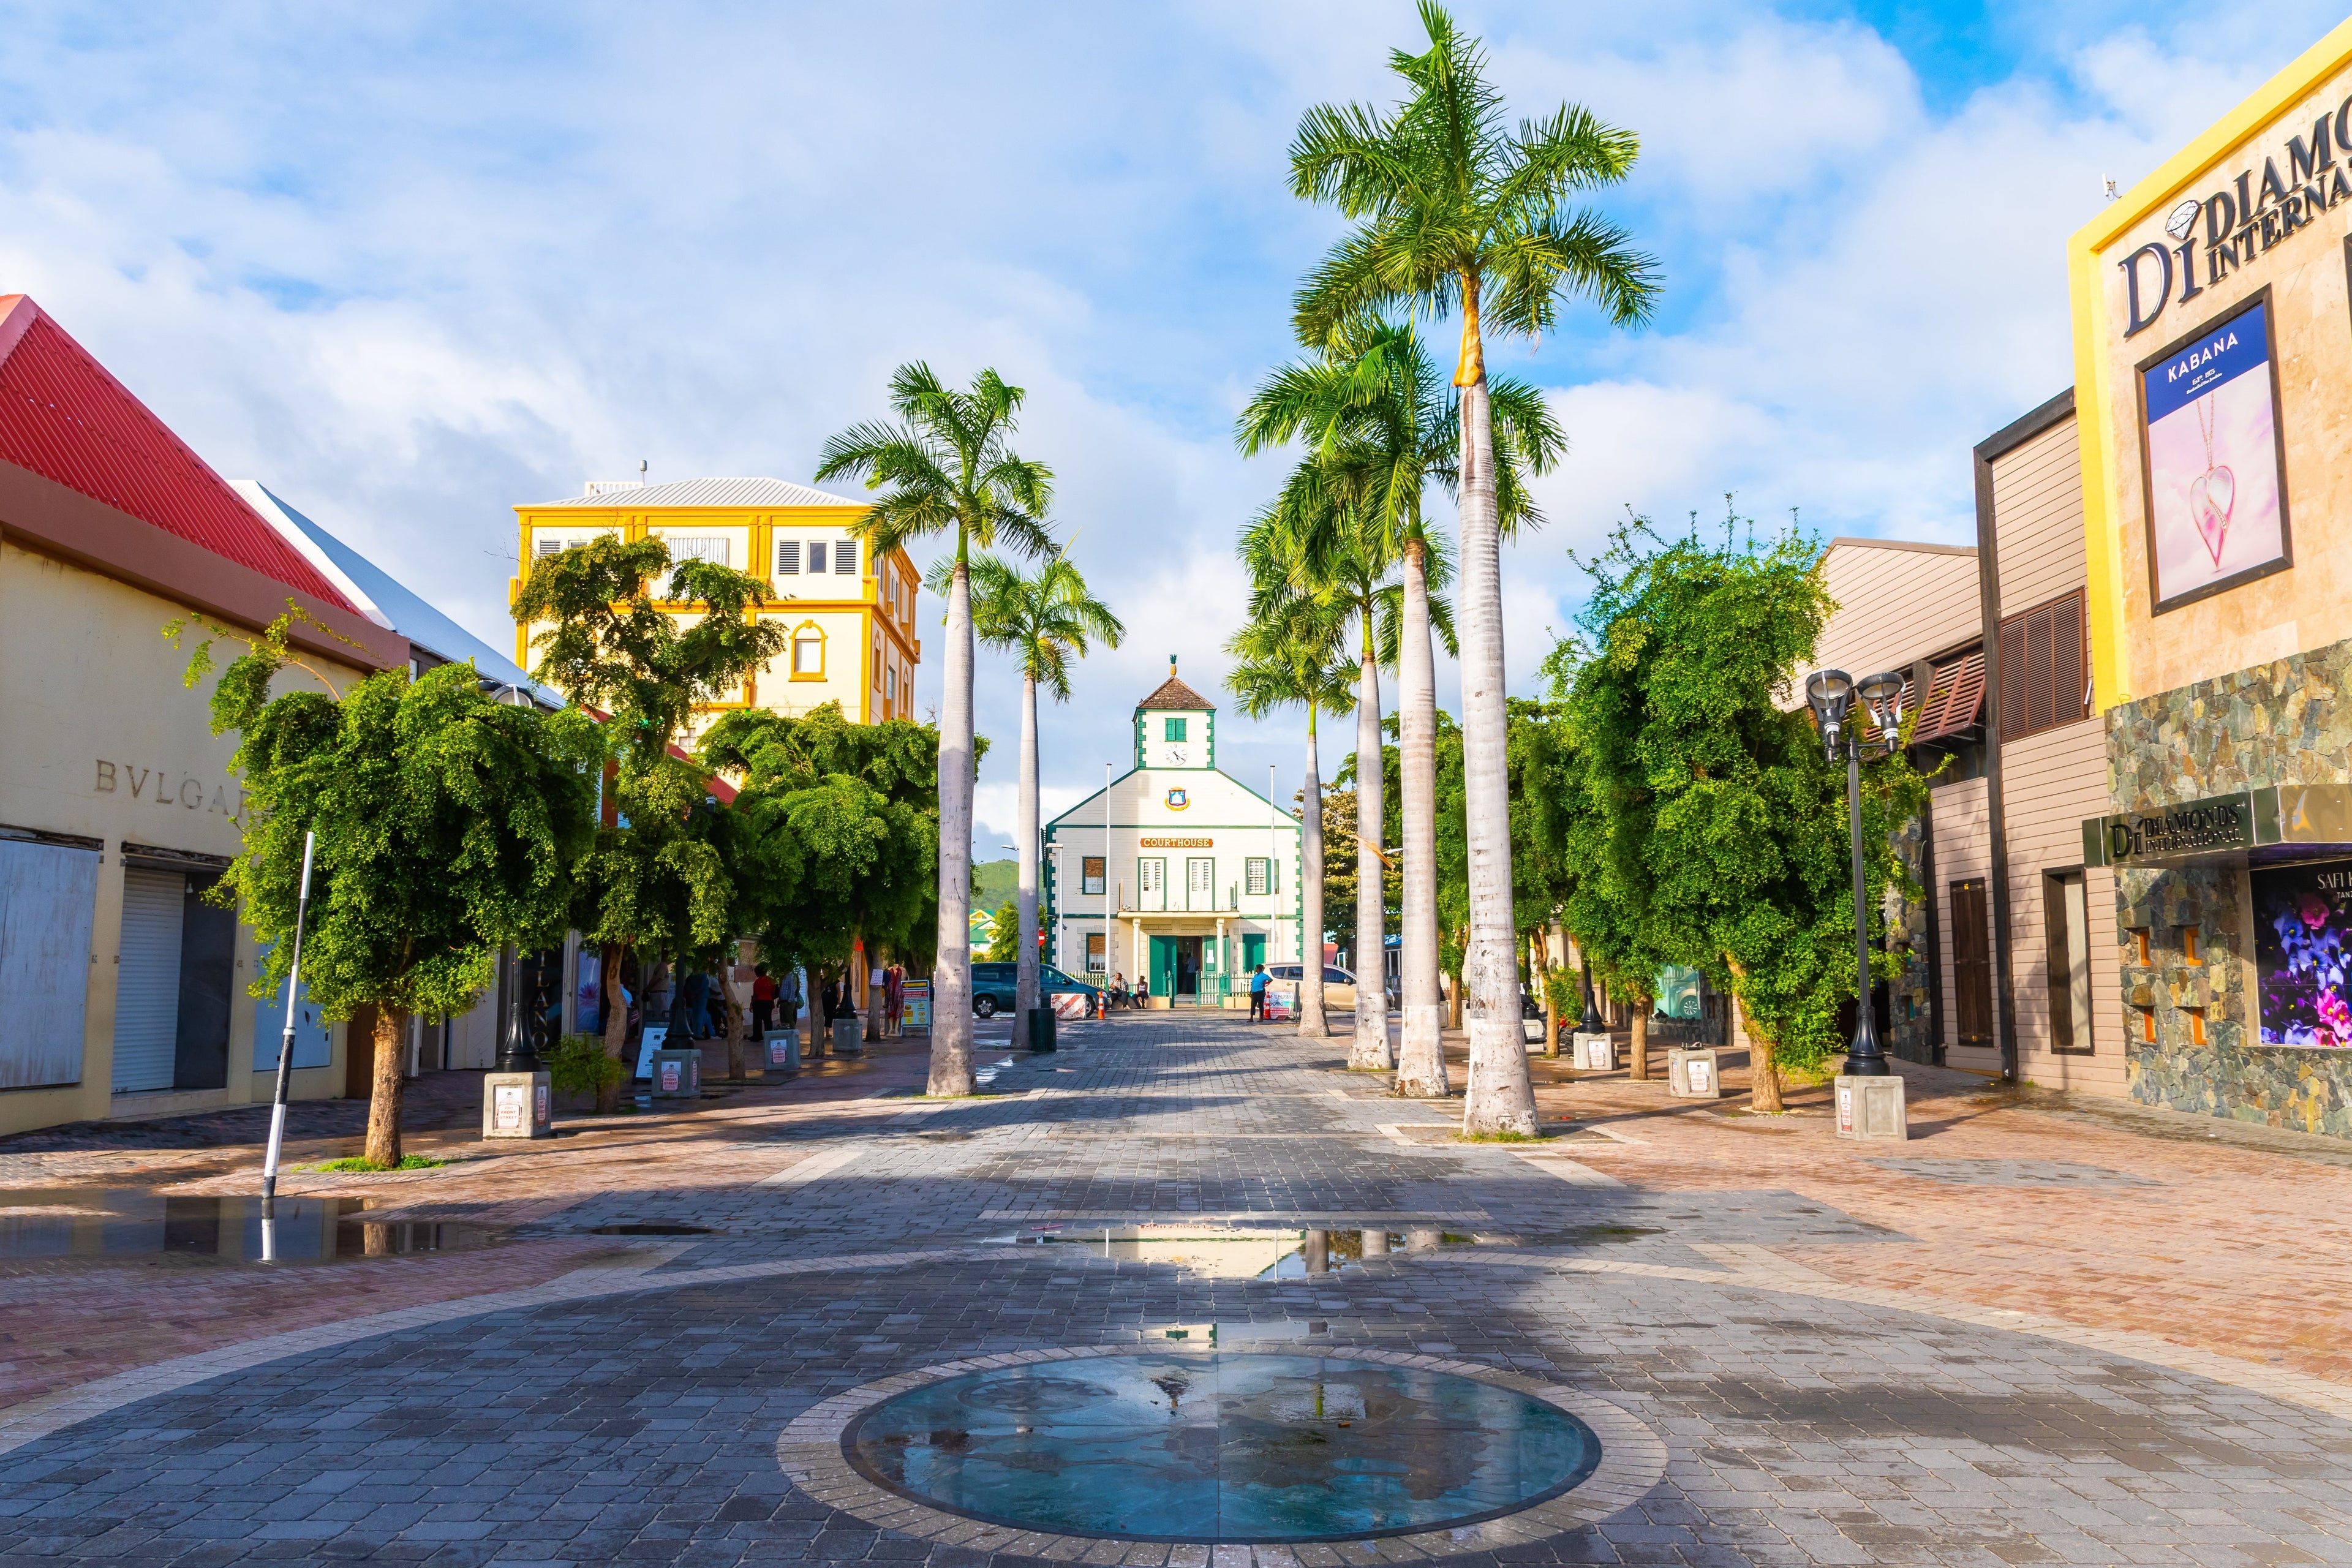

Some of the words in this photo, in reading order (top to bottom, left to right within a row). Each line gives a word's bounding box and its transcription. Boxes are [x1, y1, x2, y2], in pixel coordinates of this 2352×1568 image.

[2206, 156, 2352, 285] INTERNA
[2168, 332, 2238, 383] KABANA
[2144, 803, 2240, 837] DIAMONDS
[1144, 839, 1210, 847] COURTHOUSE
[2145, 827, 2244, 853] INTERNATIONAL
[2317, 872, 2344, 889] SAFI
